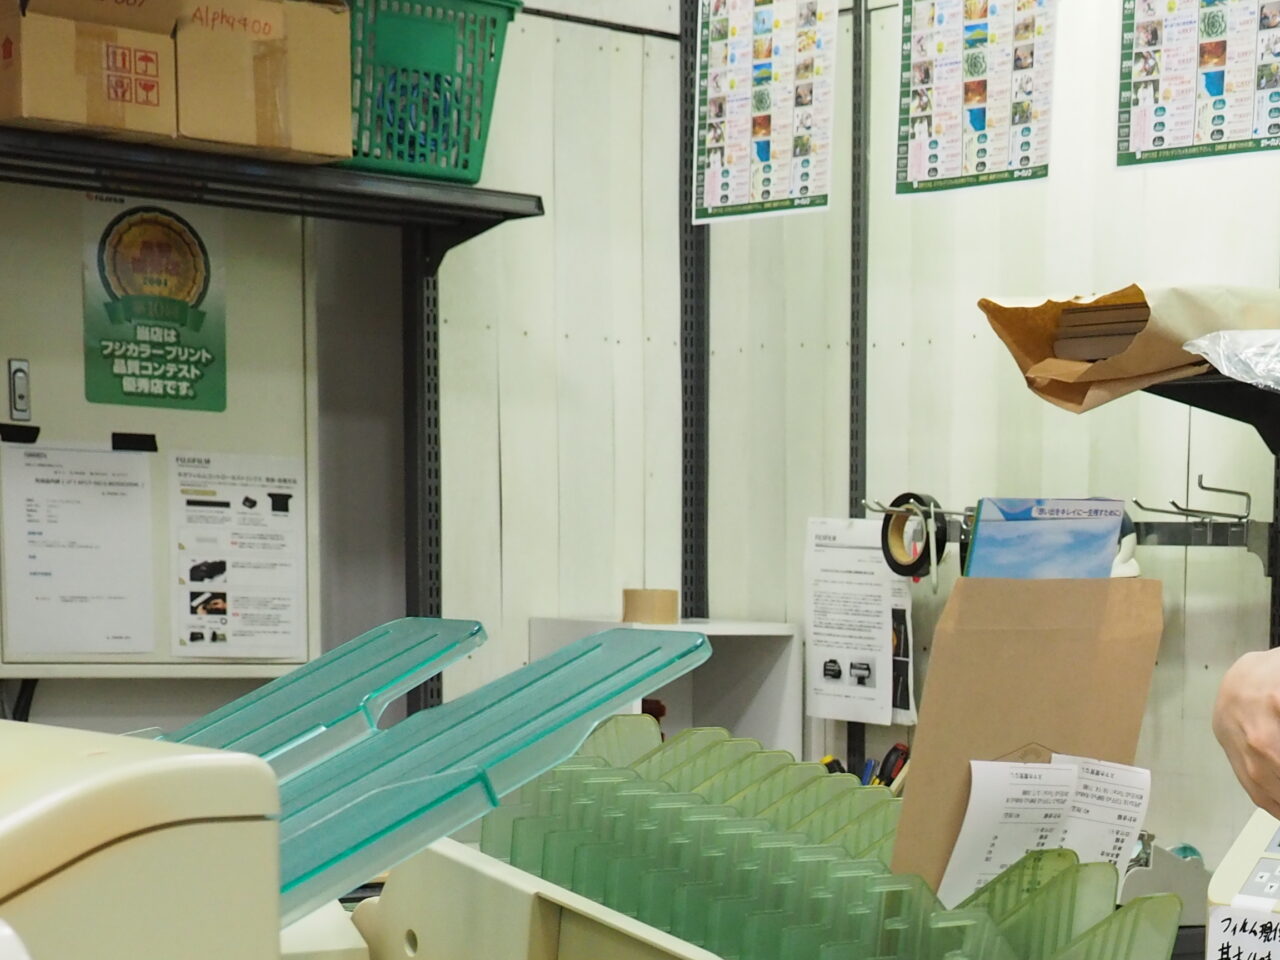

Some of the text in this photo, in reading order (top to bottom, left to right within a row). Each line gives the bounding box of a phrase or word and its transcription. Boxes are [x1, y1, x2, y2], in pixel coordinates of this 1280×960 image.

[136, 325, 177, 343] 当店は
[101, 341, 213, 364] フジカラープリント
